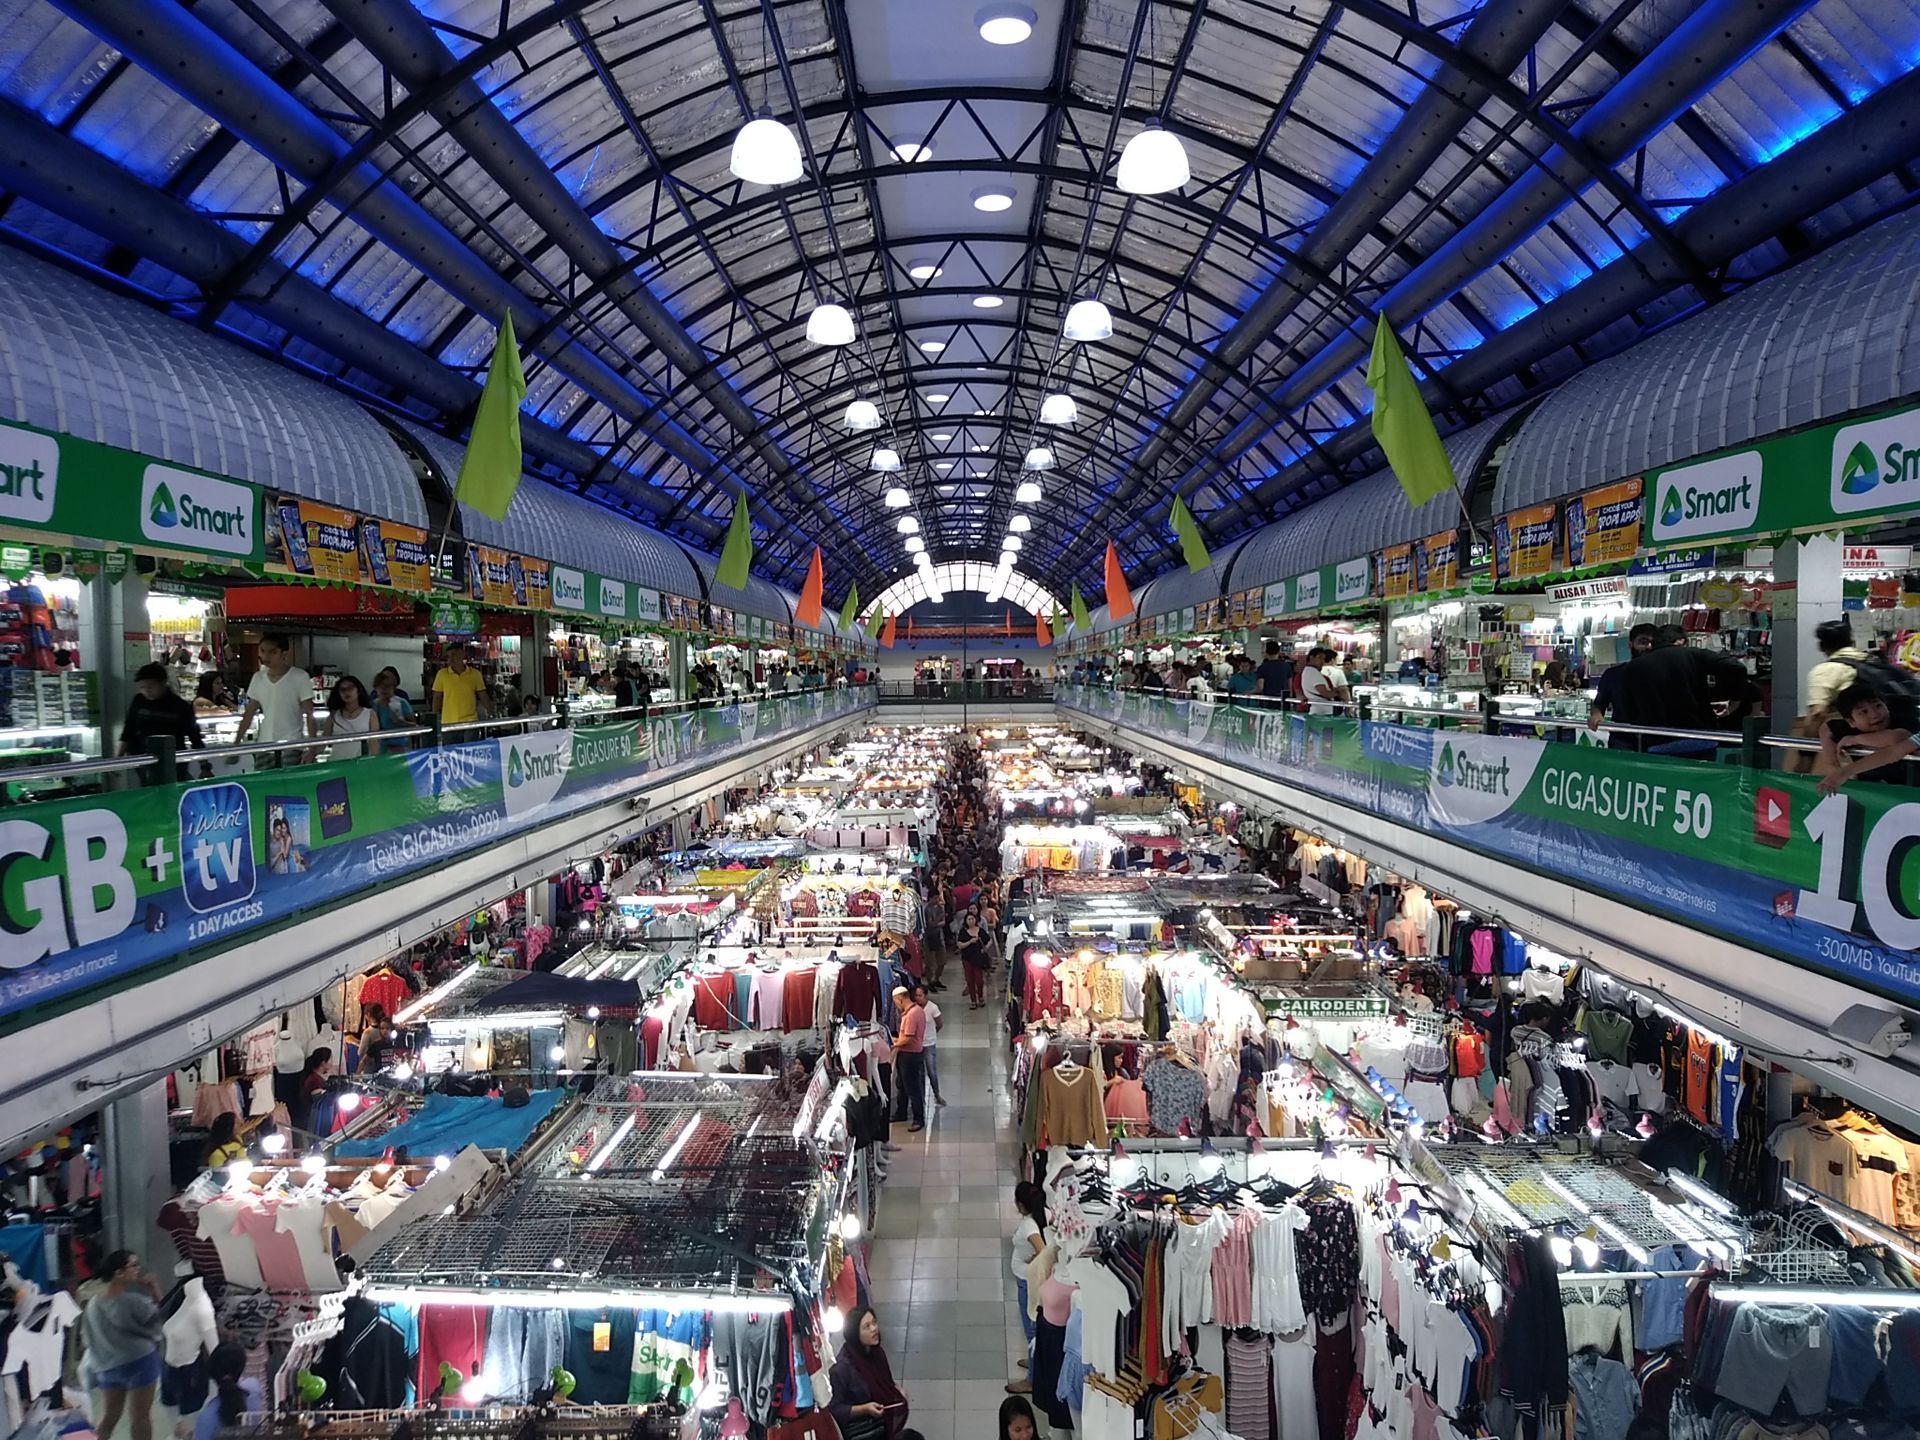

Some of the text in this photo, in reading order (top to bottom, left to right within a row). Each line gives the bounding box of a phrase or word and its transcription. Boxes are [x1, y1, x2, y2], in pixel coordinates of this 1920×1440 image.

[1685, 476, 1752, 520] Smart
[180, 494, 246, 539] Smart
[563, 577, 582, 600] Smart
[1304, 583, 1319, 599] Smart
[1345, 570, 1365, 590] Smart
[1553, 578, 1626, 600] ALISAH TELECOM
[608, 590, 623, 608] Smart
[645, 598, 658, 613] Smart
[524, 744, 562, 782] Smart
[576, 735, 631, 768] GIGASURF 50
[1457, 751, 1510, 796] Smart
[1542, 768, 1713, 839] GIGASURF 50
[366, 810, 500, 872] Text GIGA50 to 9999
[194, 837, 243, 891] tv
[0, 809, 137, 969] GB
[1619, 872, 1633, 887] ASC
[1632, 876, 1646, 889] REF
[1646, 881, 1665, 896] Code:
[188, 901, 264, 941] 1 DAY ACCESS
[62, 960, 85, 982] and
[86, 949, 118, 972] more!
[1815, 935, 1873, 971] +300MB
[1280, 1000, 1367, 1011] CAIRODEN
